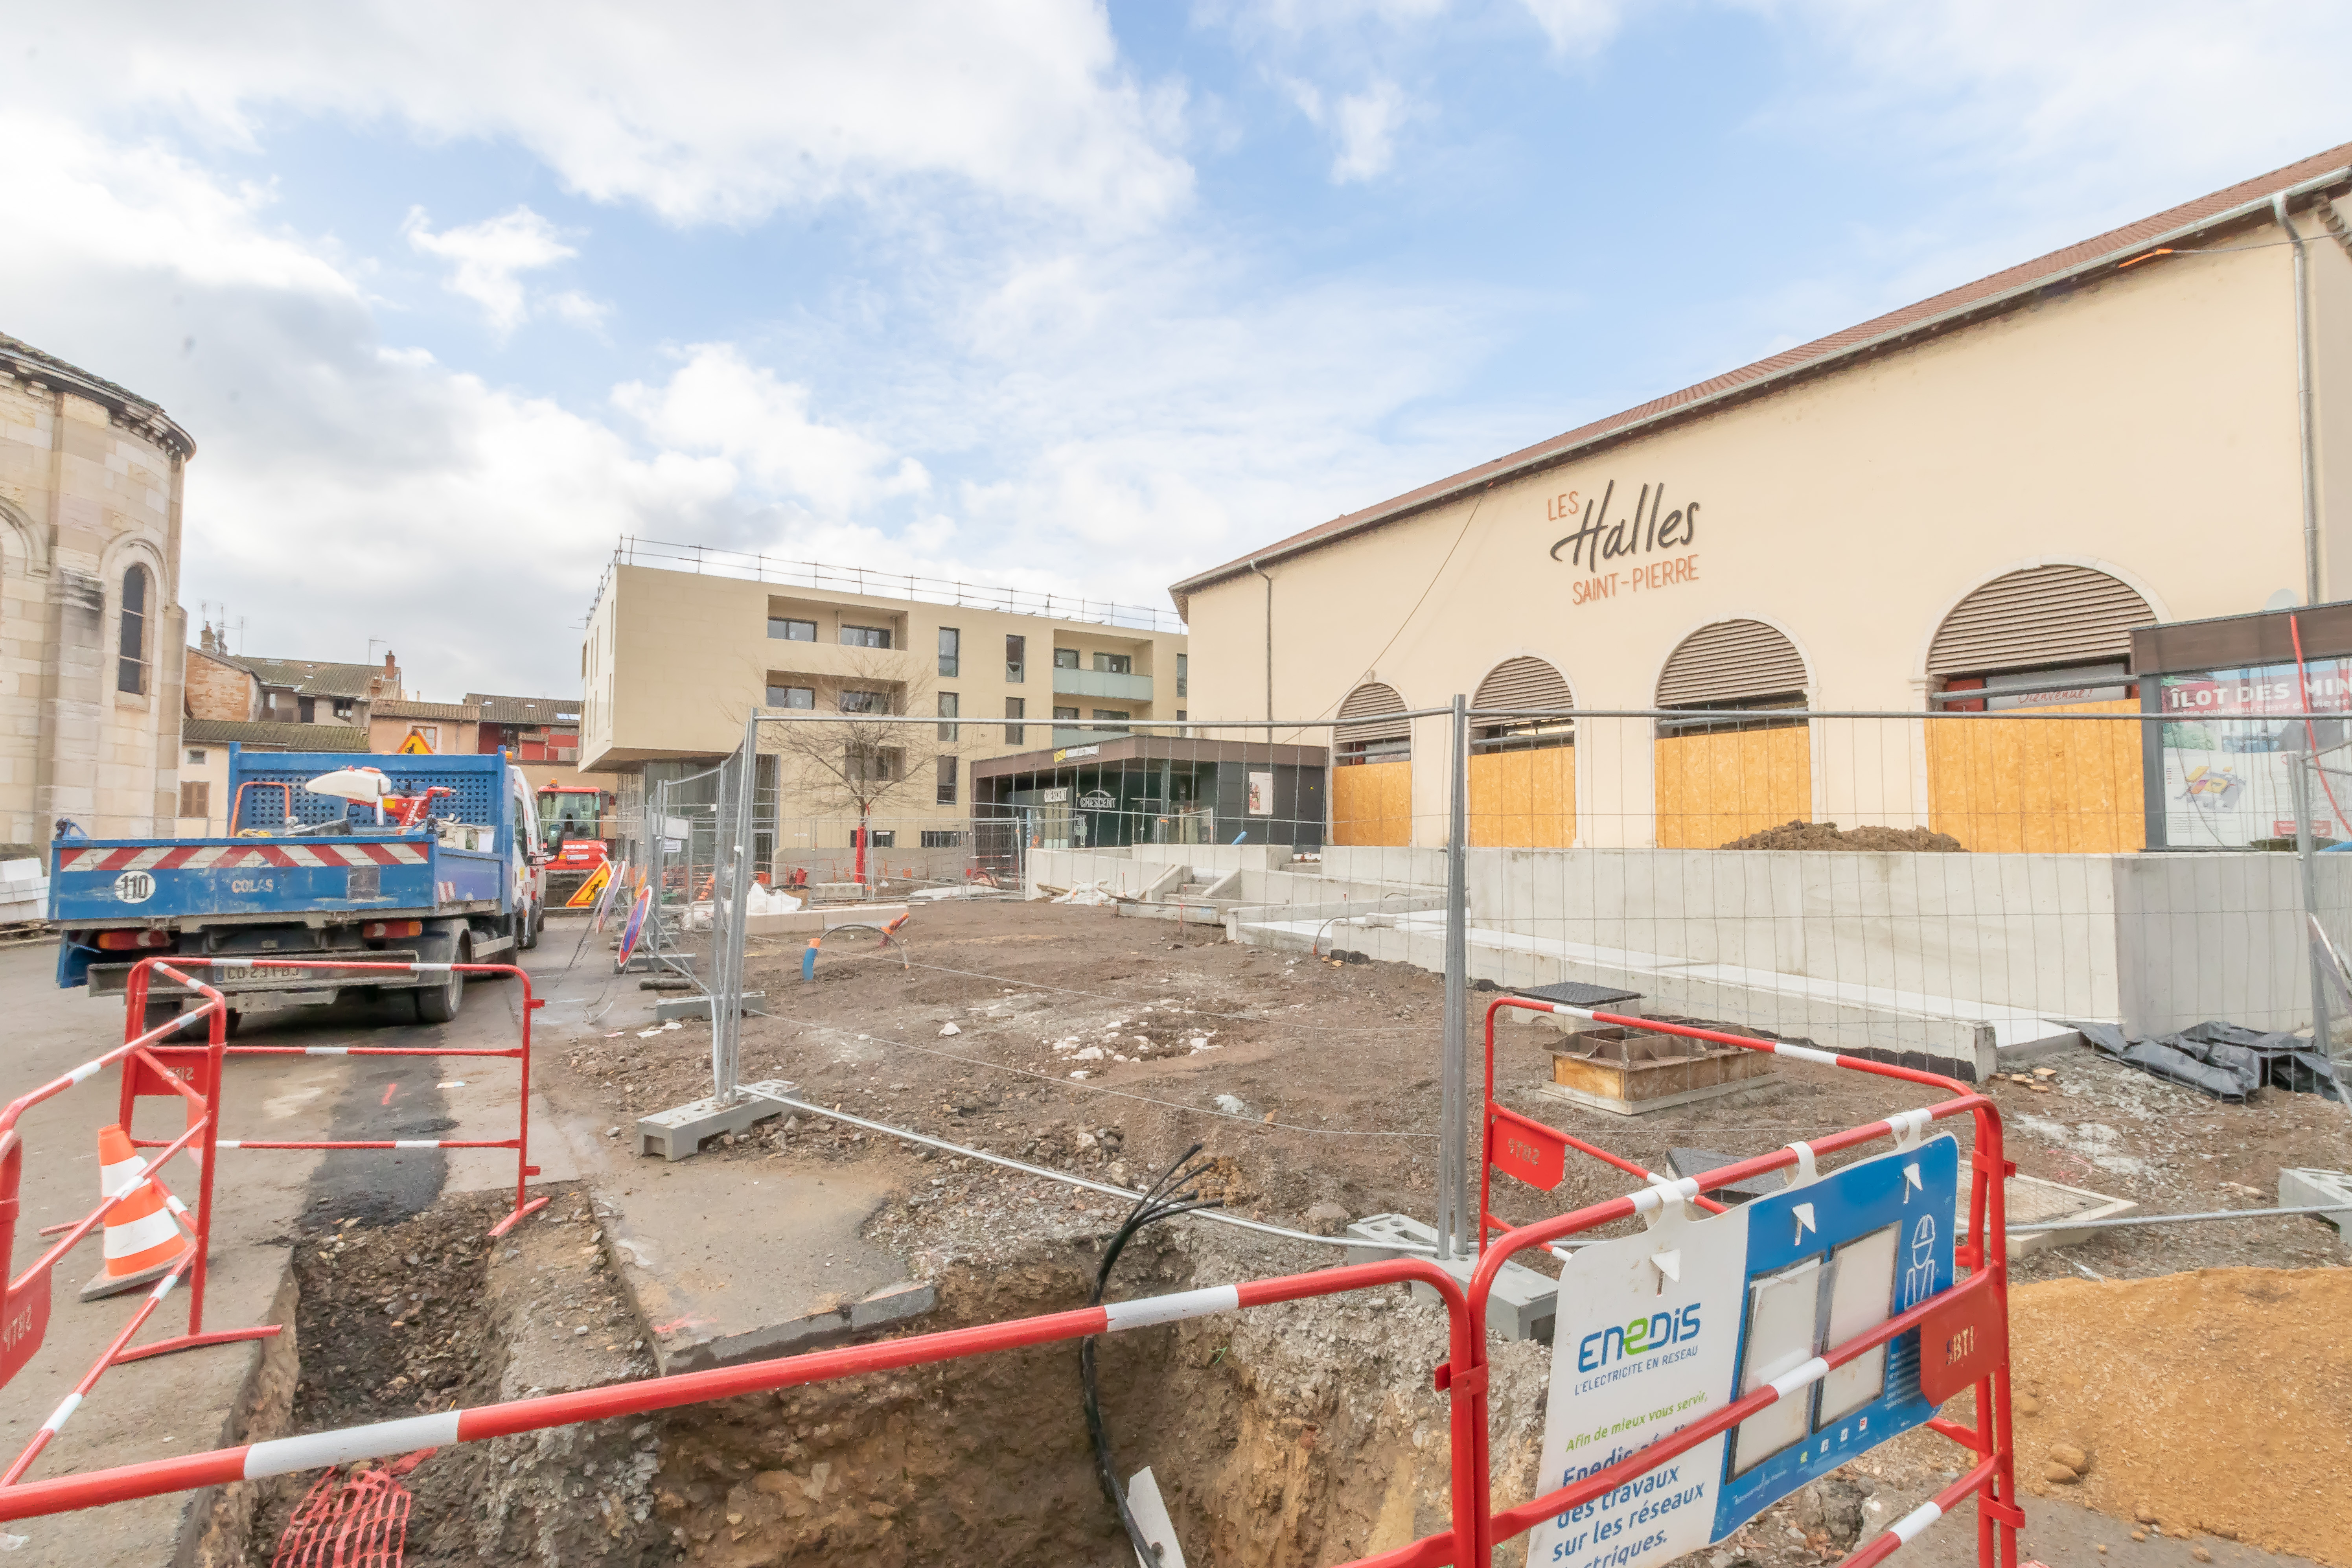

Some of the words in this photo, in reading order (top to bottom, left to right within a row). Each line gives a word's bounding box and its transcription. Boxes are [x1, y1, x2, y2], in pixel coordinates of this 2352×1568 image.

[1548, 491, 1579, 521] LES
[1550, 479, 1699, 573] Halles
[1573, 554, 1699, 605] SAINT-PIERRE
[2170, 688, 2229, 709] ÎLOT
[2236, 682, 2291, 703] DES
[121, 875, 148, 899] 110
[1574, 1361, 1643, 1396] L'ELECTRICITE
[1646, 1357, 1659, 1370] EN
[1662, 1345, 1698, 1366] RESEAU
[1566, 1433, 1591, 1453] Afin
[1594, 1426, 1608, 1441] de
[1611, 1415, 1646, 1435] mieux
[1649, 1404, 1674, 1422] vous
[1677, 1390, 1707, 1412] servir,
[1601, 1465, 1680, 1511] travaux
[1552, 1531, 1588, 1562] sur
[1593, 1517, 1623, 1544] les
[1629, 1481, 1706, 1529] réseaux
